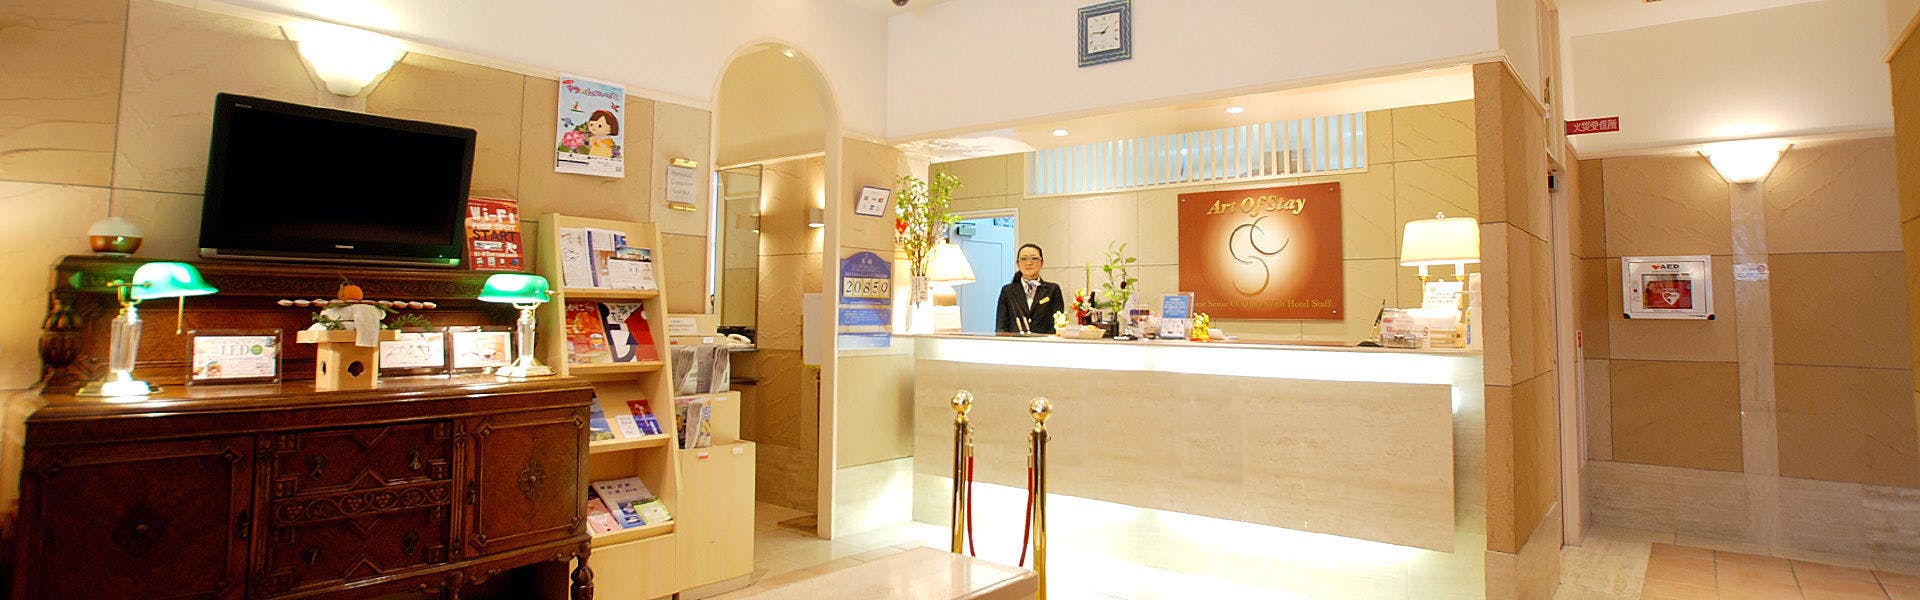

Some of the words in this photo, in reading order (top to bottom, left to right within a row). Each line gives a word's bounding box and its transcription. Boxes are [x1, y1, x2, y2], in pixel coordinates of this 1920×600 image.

[1207, 199, 1237, 215] Art
[1240, 195, 1267, 218] Of
[1266, 194, 1306, 215] Stay
[469, 206, 516, 224] Wi-Fi
[472, 229, 517, 242] START
[1288, 299, 1309, 308] Hotel
